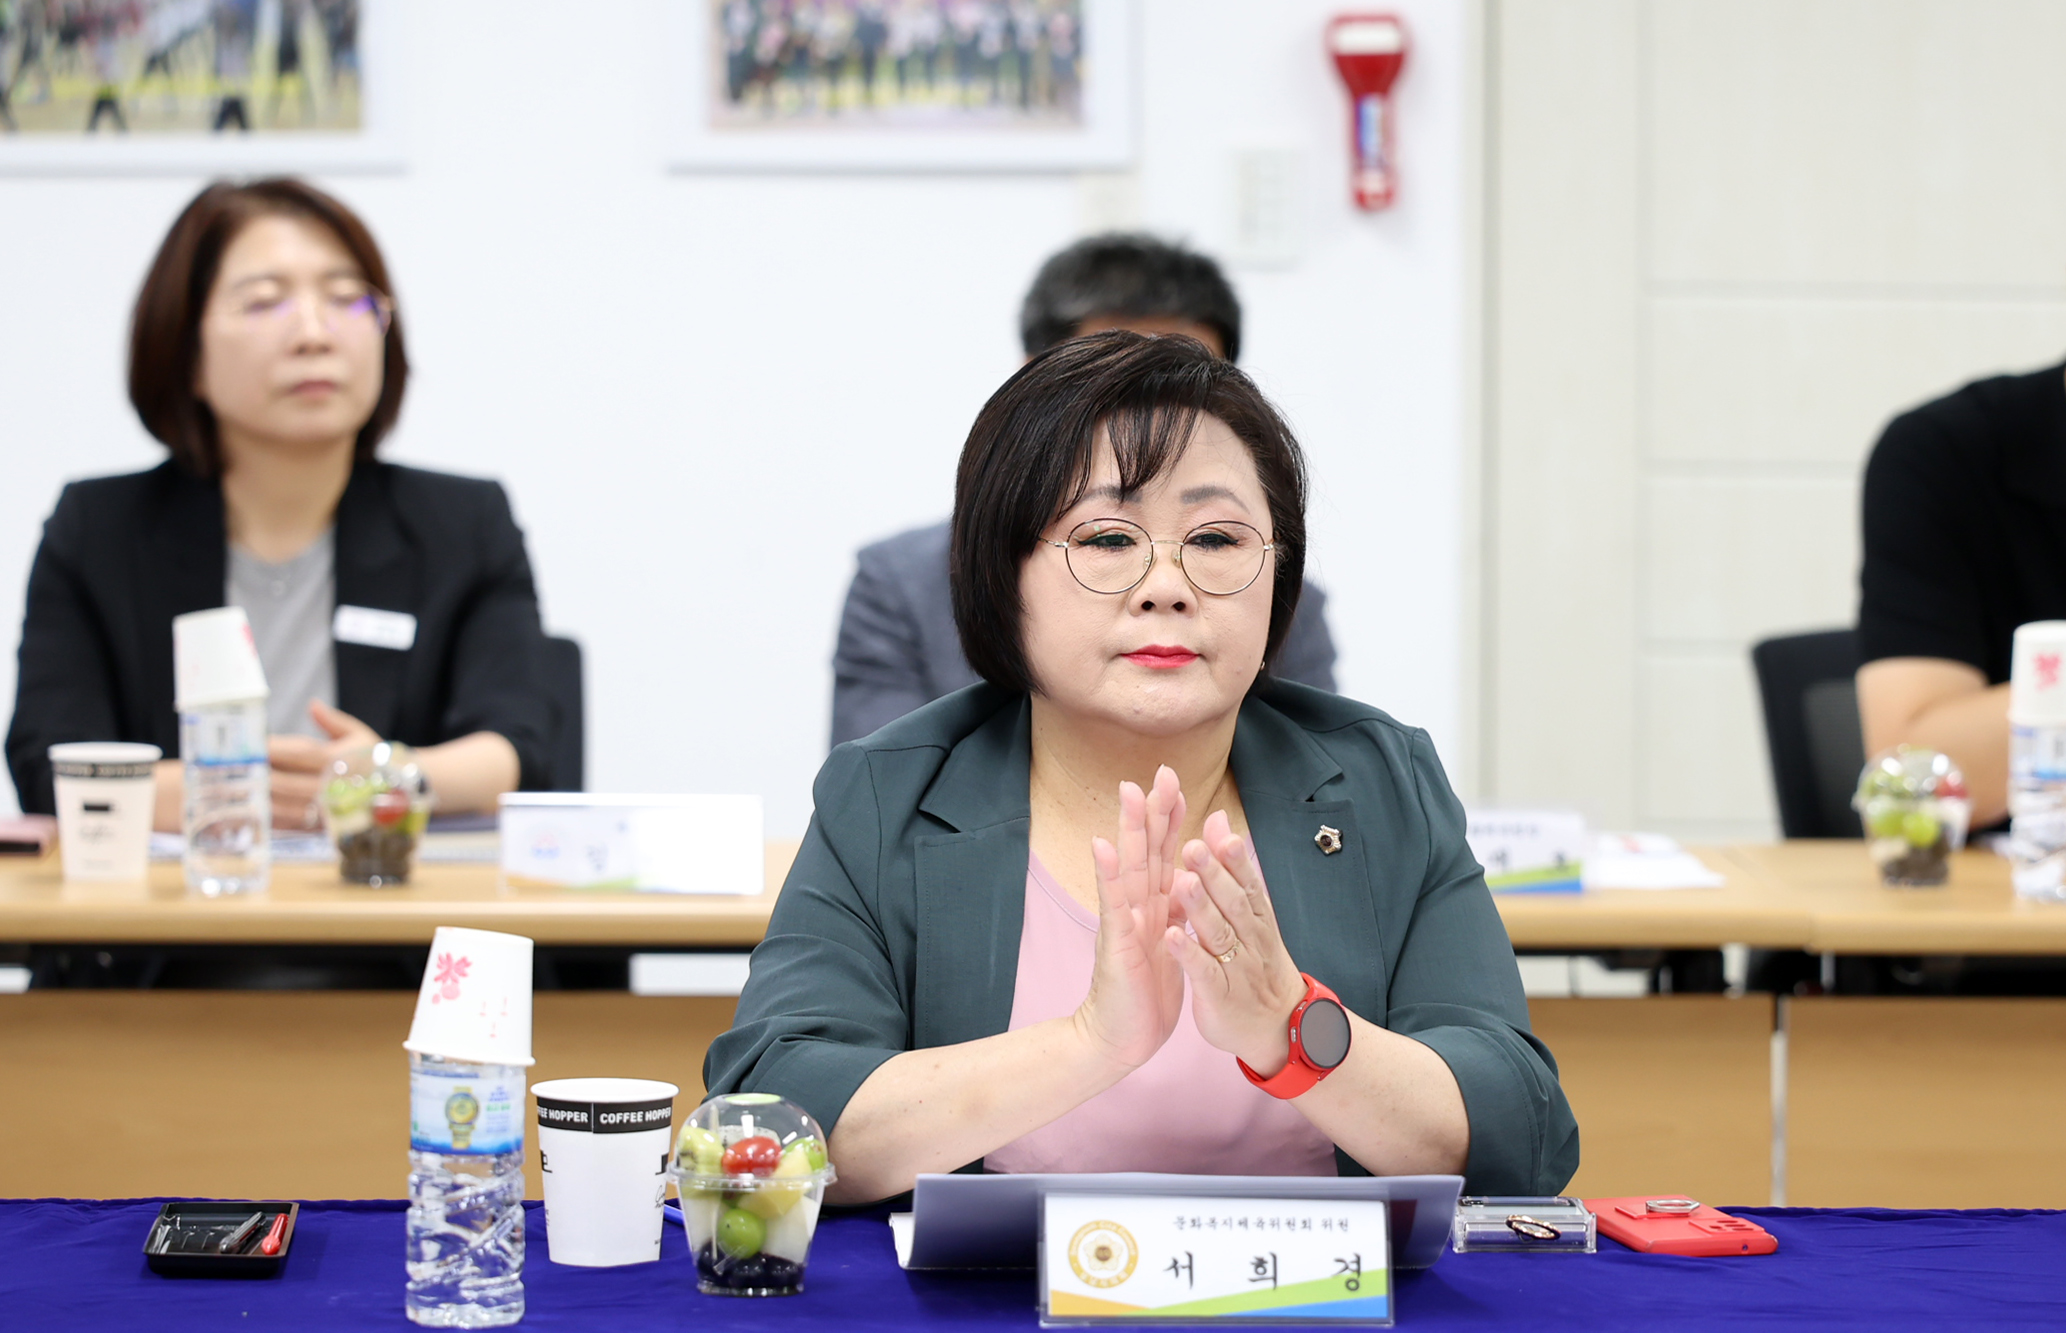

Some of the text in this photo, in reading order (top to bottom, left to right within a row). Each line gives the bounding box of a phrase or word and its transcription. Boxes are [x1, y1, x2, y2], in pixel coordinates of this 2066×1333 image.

[549, 1108, 588, 1123] HOPPER
[600, 1111, 643, 1124] COFFEE
[1173, 1216, 1349, 1232] 문화복지체육위원회 위원
[1163, 1251, 1194, 1289] 서
[1247, 1251, 1278, 1290] 희
[1330, 1252, 1361, 1291] 경
